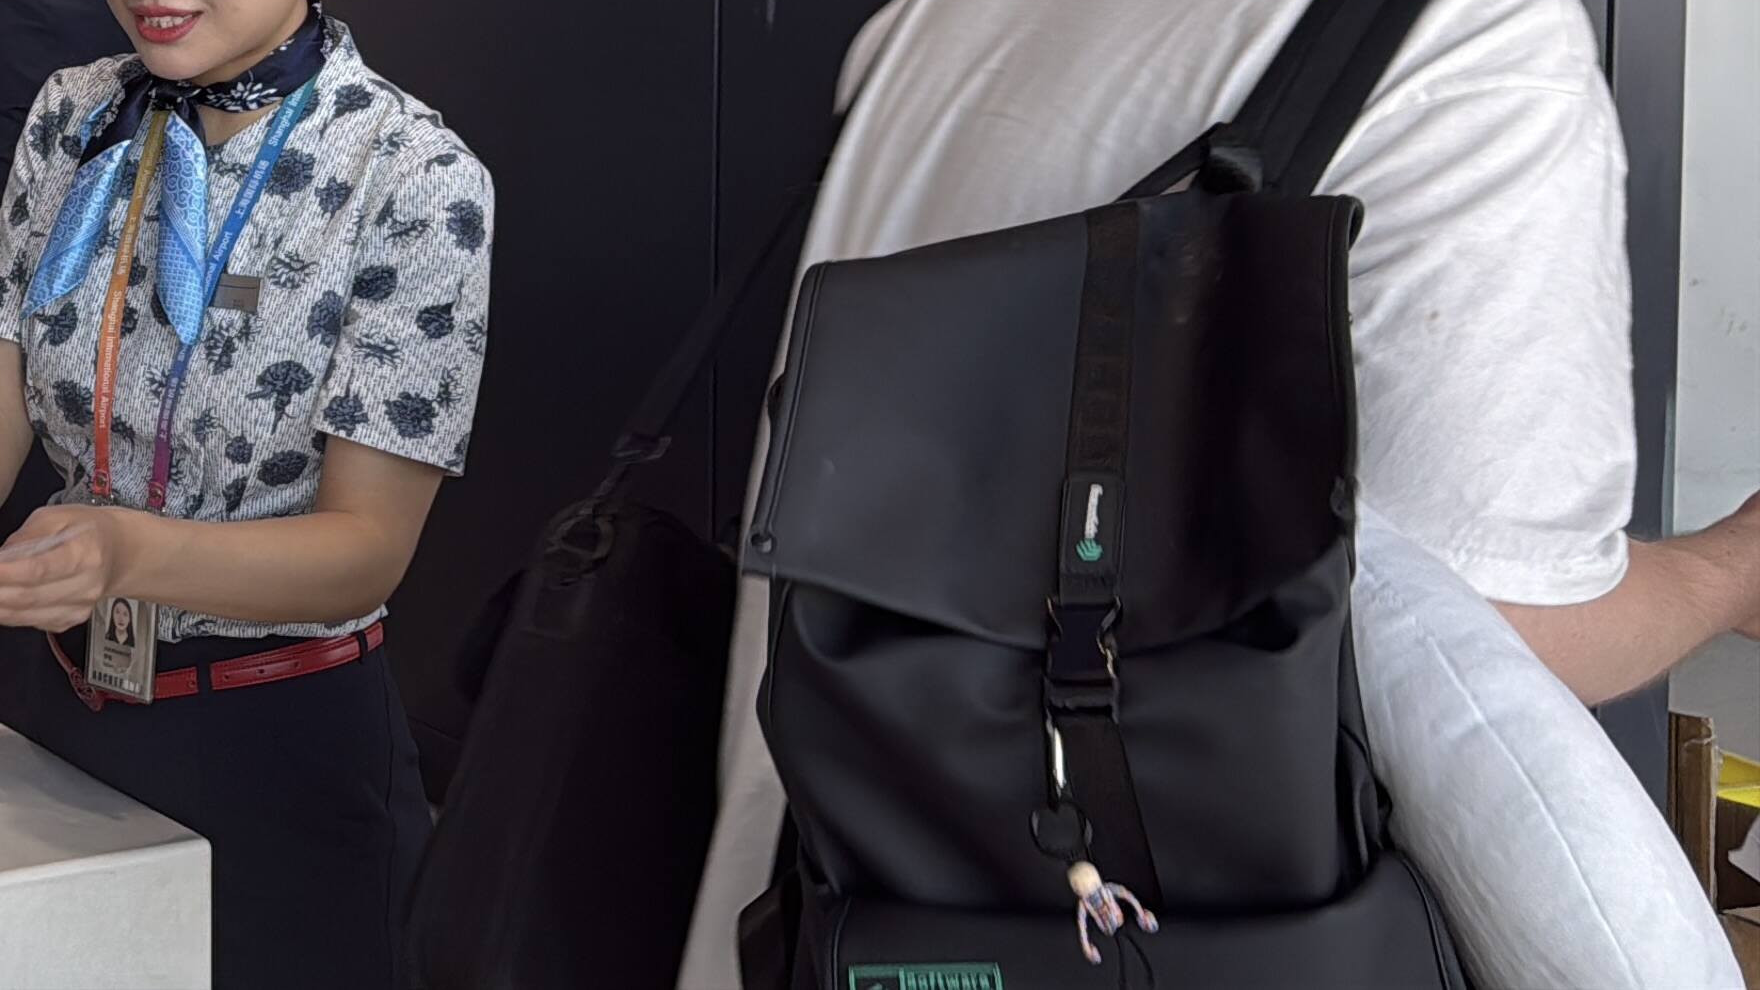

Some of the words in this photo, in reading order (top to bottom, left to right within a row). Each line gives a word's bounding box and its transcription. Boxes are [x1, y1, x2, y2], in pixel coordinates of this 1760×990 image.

[213, 231, 233, 261] Airport
[107, 290, 122, 337] Shanghai
[97, 395, 110, 429] Airport
